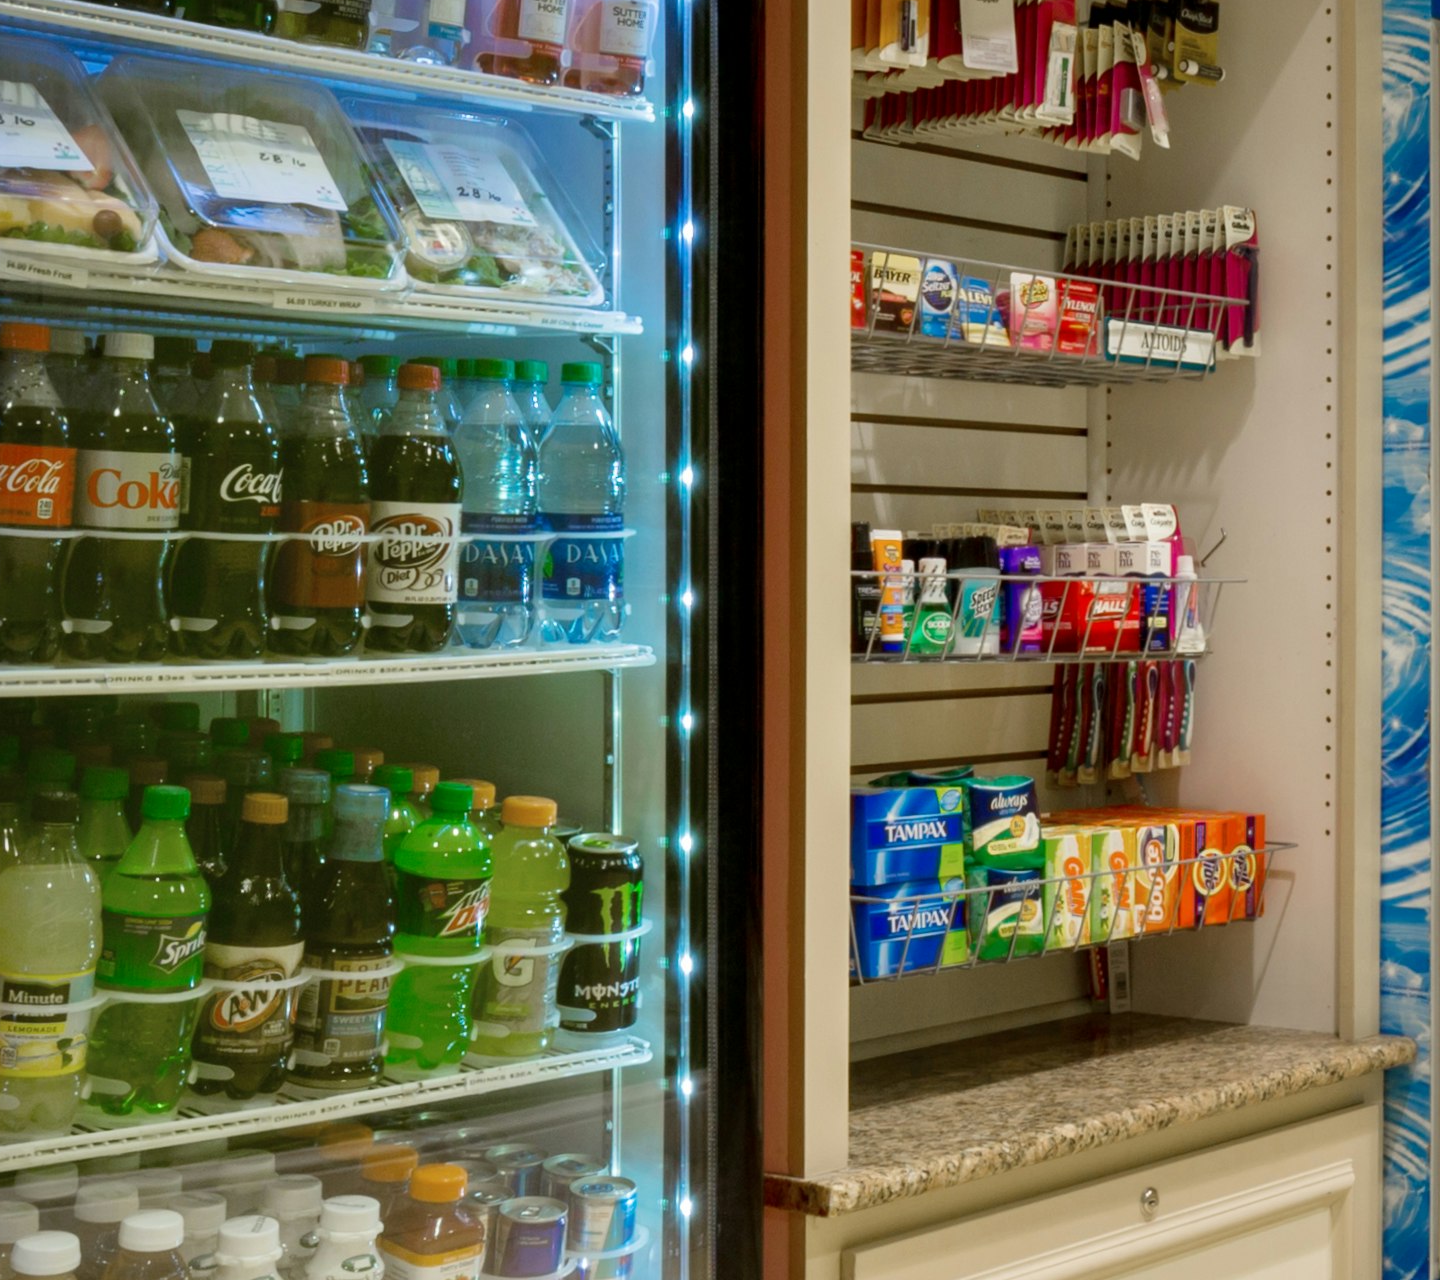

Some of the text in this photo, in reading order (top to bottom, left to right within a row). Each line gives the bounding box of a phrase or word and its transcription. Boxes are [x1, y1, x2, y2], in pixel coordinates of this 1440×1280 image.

[617, 17, 645, 30] HOME
[29, 264, 51, 276] Fresh
[874, 268, 911, 284] BAYER
[308, 298, 337, 308] TURKEY
[339, 300, 361, 309] WRAP
[1142, 331, 1187, 353] ALTOIDS
[87, 468, 179, 509] Coke
[1150, 518, 1173, 527] Colgate
[466, 542, 534, 567] DASA
[567, 542, 623, 567] DASA
[386, 567, 412, 585] Diet
[1094, 600, 1128, 613] HALLS
[991, 793, 1028, 814] always
[885, 820, 947, 844] TAMPAX
[1064, 857, 1086, 918] GAIN
[1110, 851, 1129, 909] GAIN
[888, 907, 950, 933] TAMPAX
[494, 938, 536, 987] G
[9, 989, 64, 1005] Minute
[8, 1025, 58, 1034] LEMONADE
